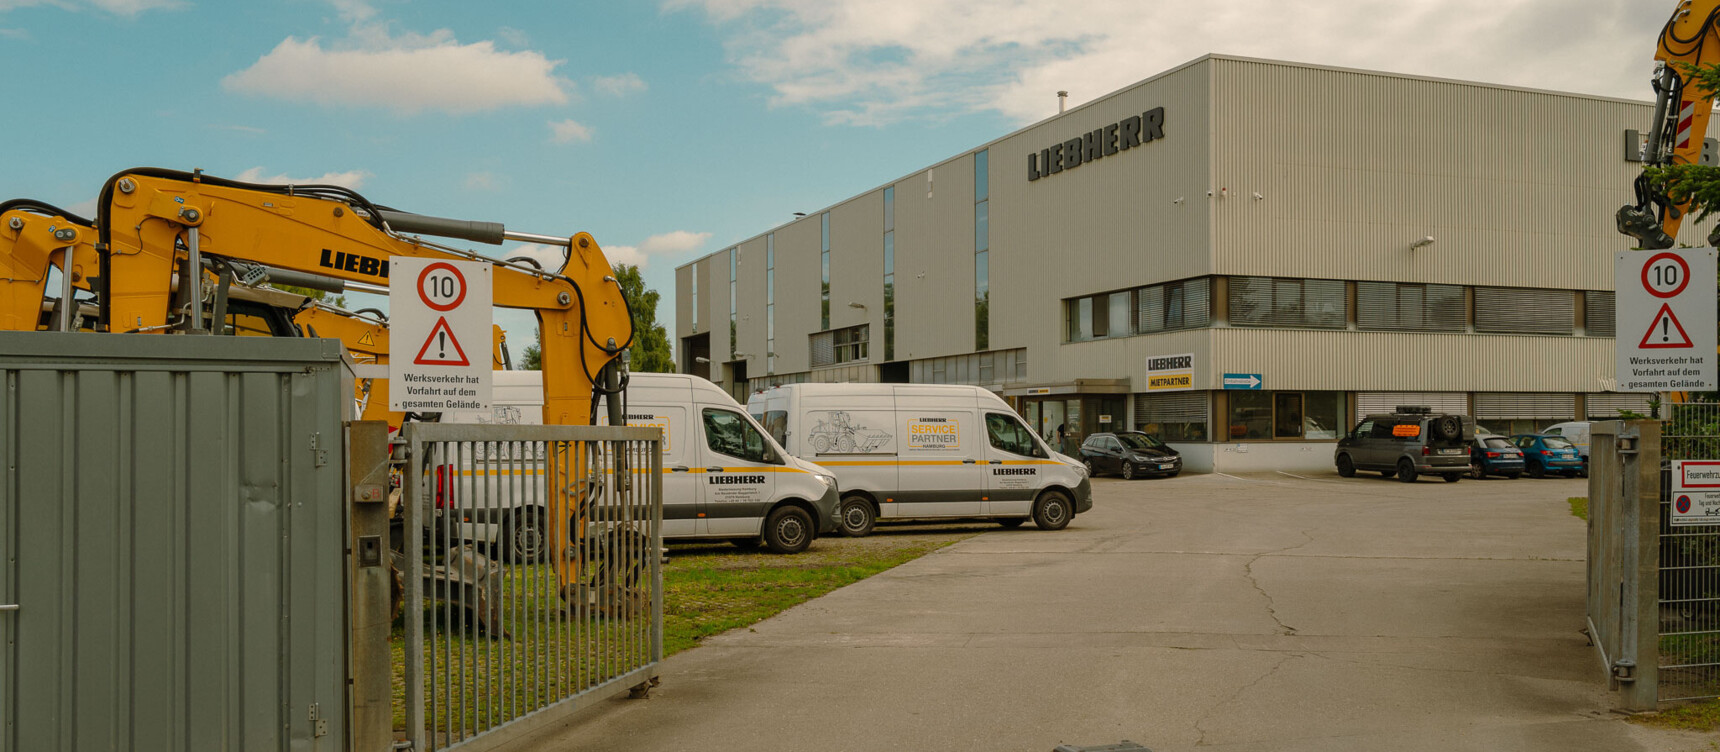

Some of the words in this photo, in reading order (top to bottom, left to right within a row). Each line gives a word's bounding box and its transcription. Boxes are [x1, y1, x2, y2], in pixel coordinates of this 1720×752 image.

[1028, 106, 1165, 182] LIEBHERR
[1654, 265, 1677, 286] 10
[430, 275, 454, 298] 10
[1148, 355, 1192, 371] LIEBHERR
[1629, 356, 1688, 365] Werksverkehr
[1689, 356, 1703, 365] hat
[1632, 368, 1665, 377] Vorfahrt
[1667, 367, 1680, 377] auf
[1682, 368, 1701, 377] dem
[403, 373, 465, 384] Werksverkehr
[465, 374, 480, 384] hat
[1150, 376, 1190, 387] MIETPARTNER
[1628, 381, 1668, 389] gesamten
[1669, 379, 1705, 388] Gelände
[406, 385, 441, 396] Vorfahrt
[443, 386, 457, 396] auf
[458, 387, 476, 397] dem
[402, 399, 444, 409] gesamten
[445, 398, 481, 409] Gelände
[911, 424, 956, 434] SERVICE
[911, 434, 956, 443] PARTNER
[993, 468, 1036, 476] LIEBHERR
[709, 475, 766, 485] LIEBHERR
